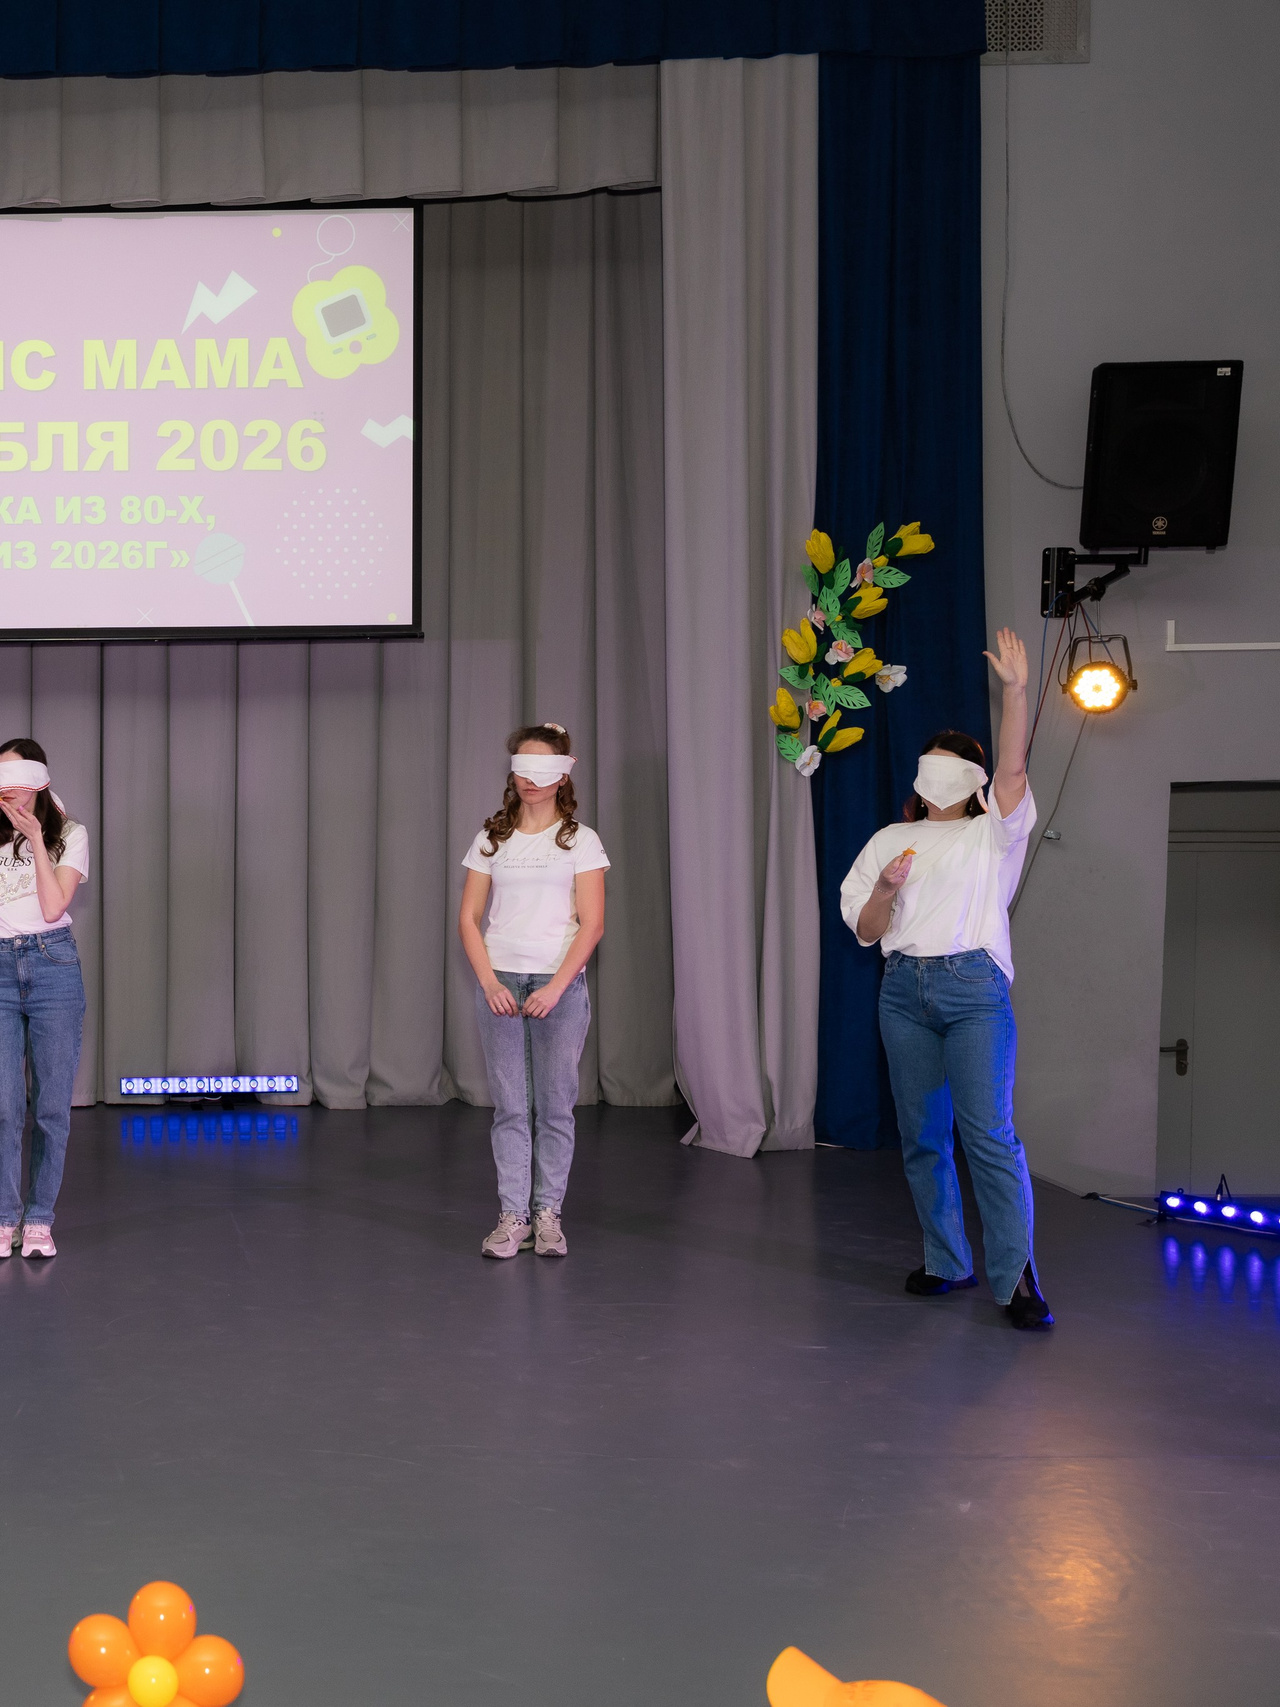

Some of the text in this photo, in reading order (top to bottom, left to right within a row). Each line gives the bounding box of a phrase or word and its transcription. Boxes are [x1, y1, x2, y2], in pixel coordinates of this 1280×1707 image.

[83, 337, 305, 391] МАМА
[155, 418, 327, 472] 2026
[55, 495, 108, 525] ИЗ
[119, 494, 217, 532] 80-Х,
[50, 540, 191, 570] 2026Г»
